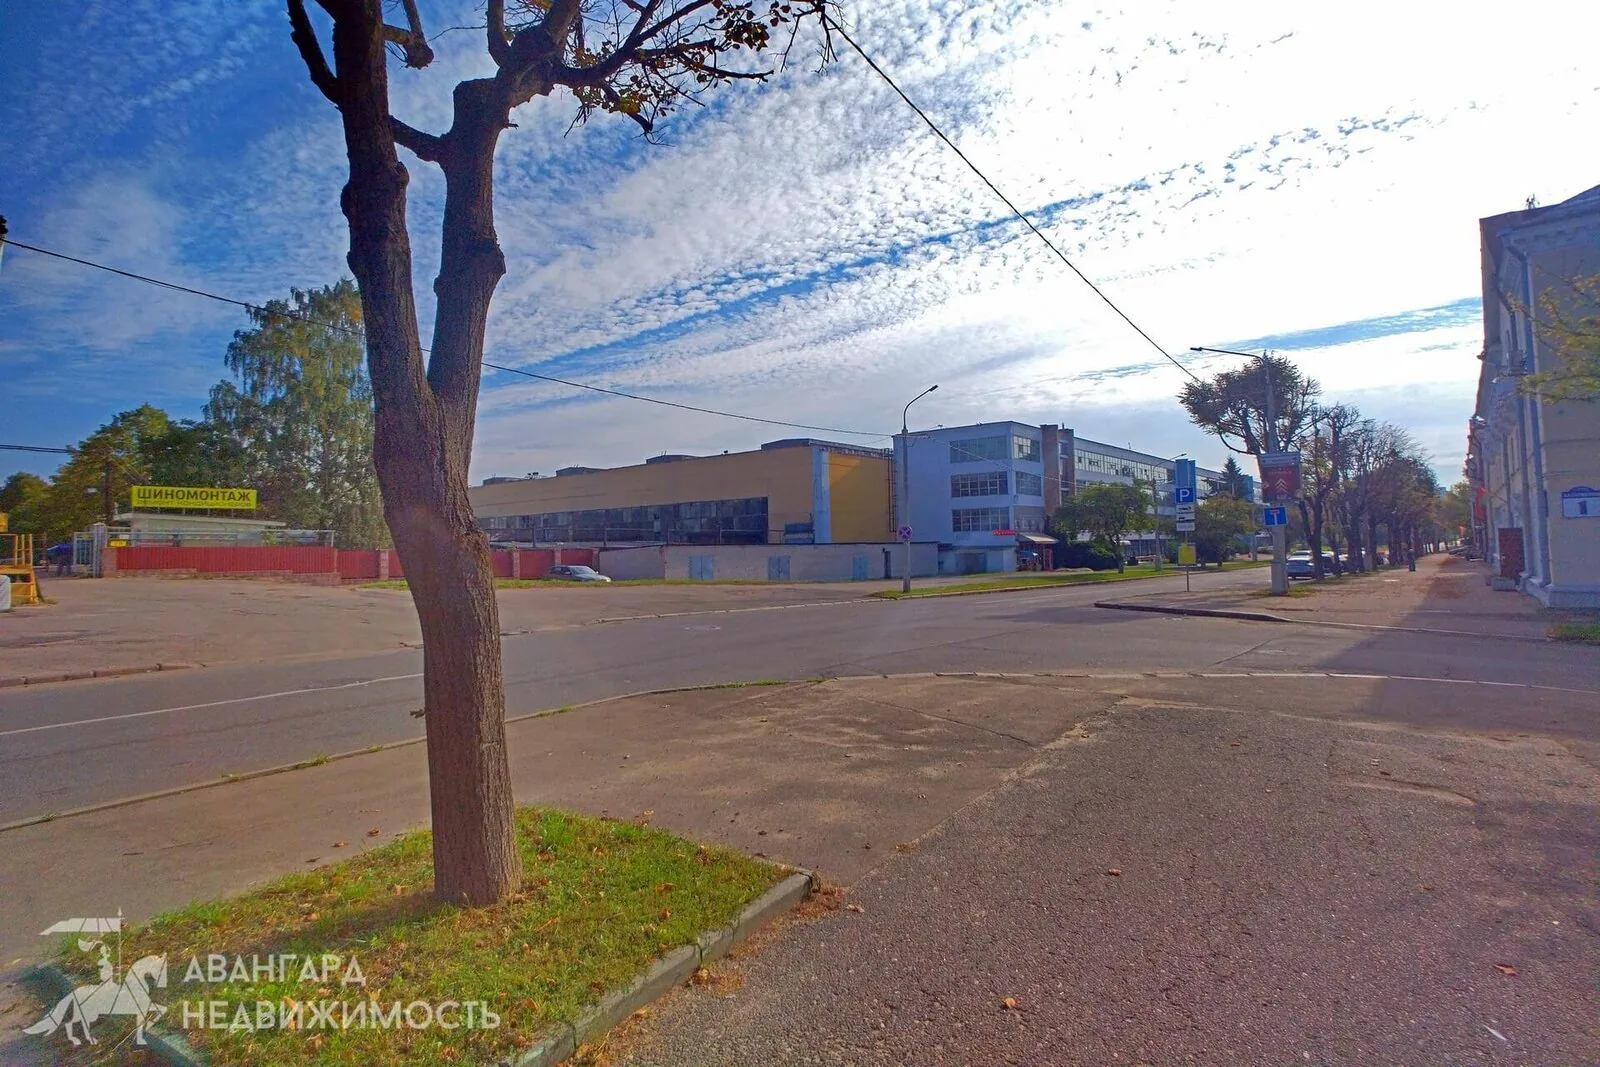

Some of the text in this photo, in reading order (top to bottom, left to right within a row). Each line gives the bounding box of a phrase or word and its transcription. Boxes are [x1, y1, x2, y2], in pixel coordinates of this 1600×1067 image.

[137, 488, 251, 501] ШИНОМОНТАЖ
[1180, 489, 1190, 502] P
[1577, 500, 1588, 515] 1
